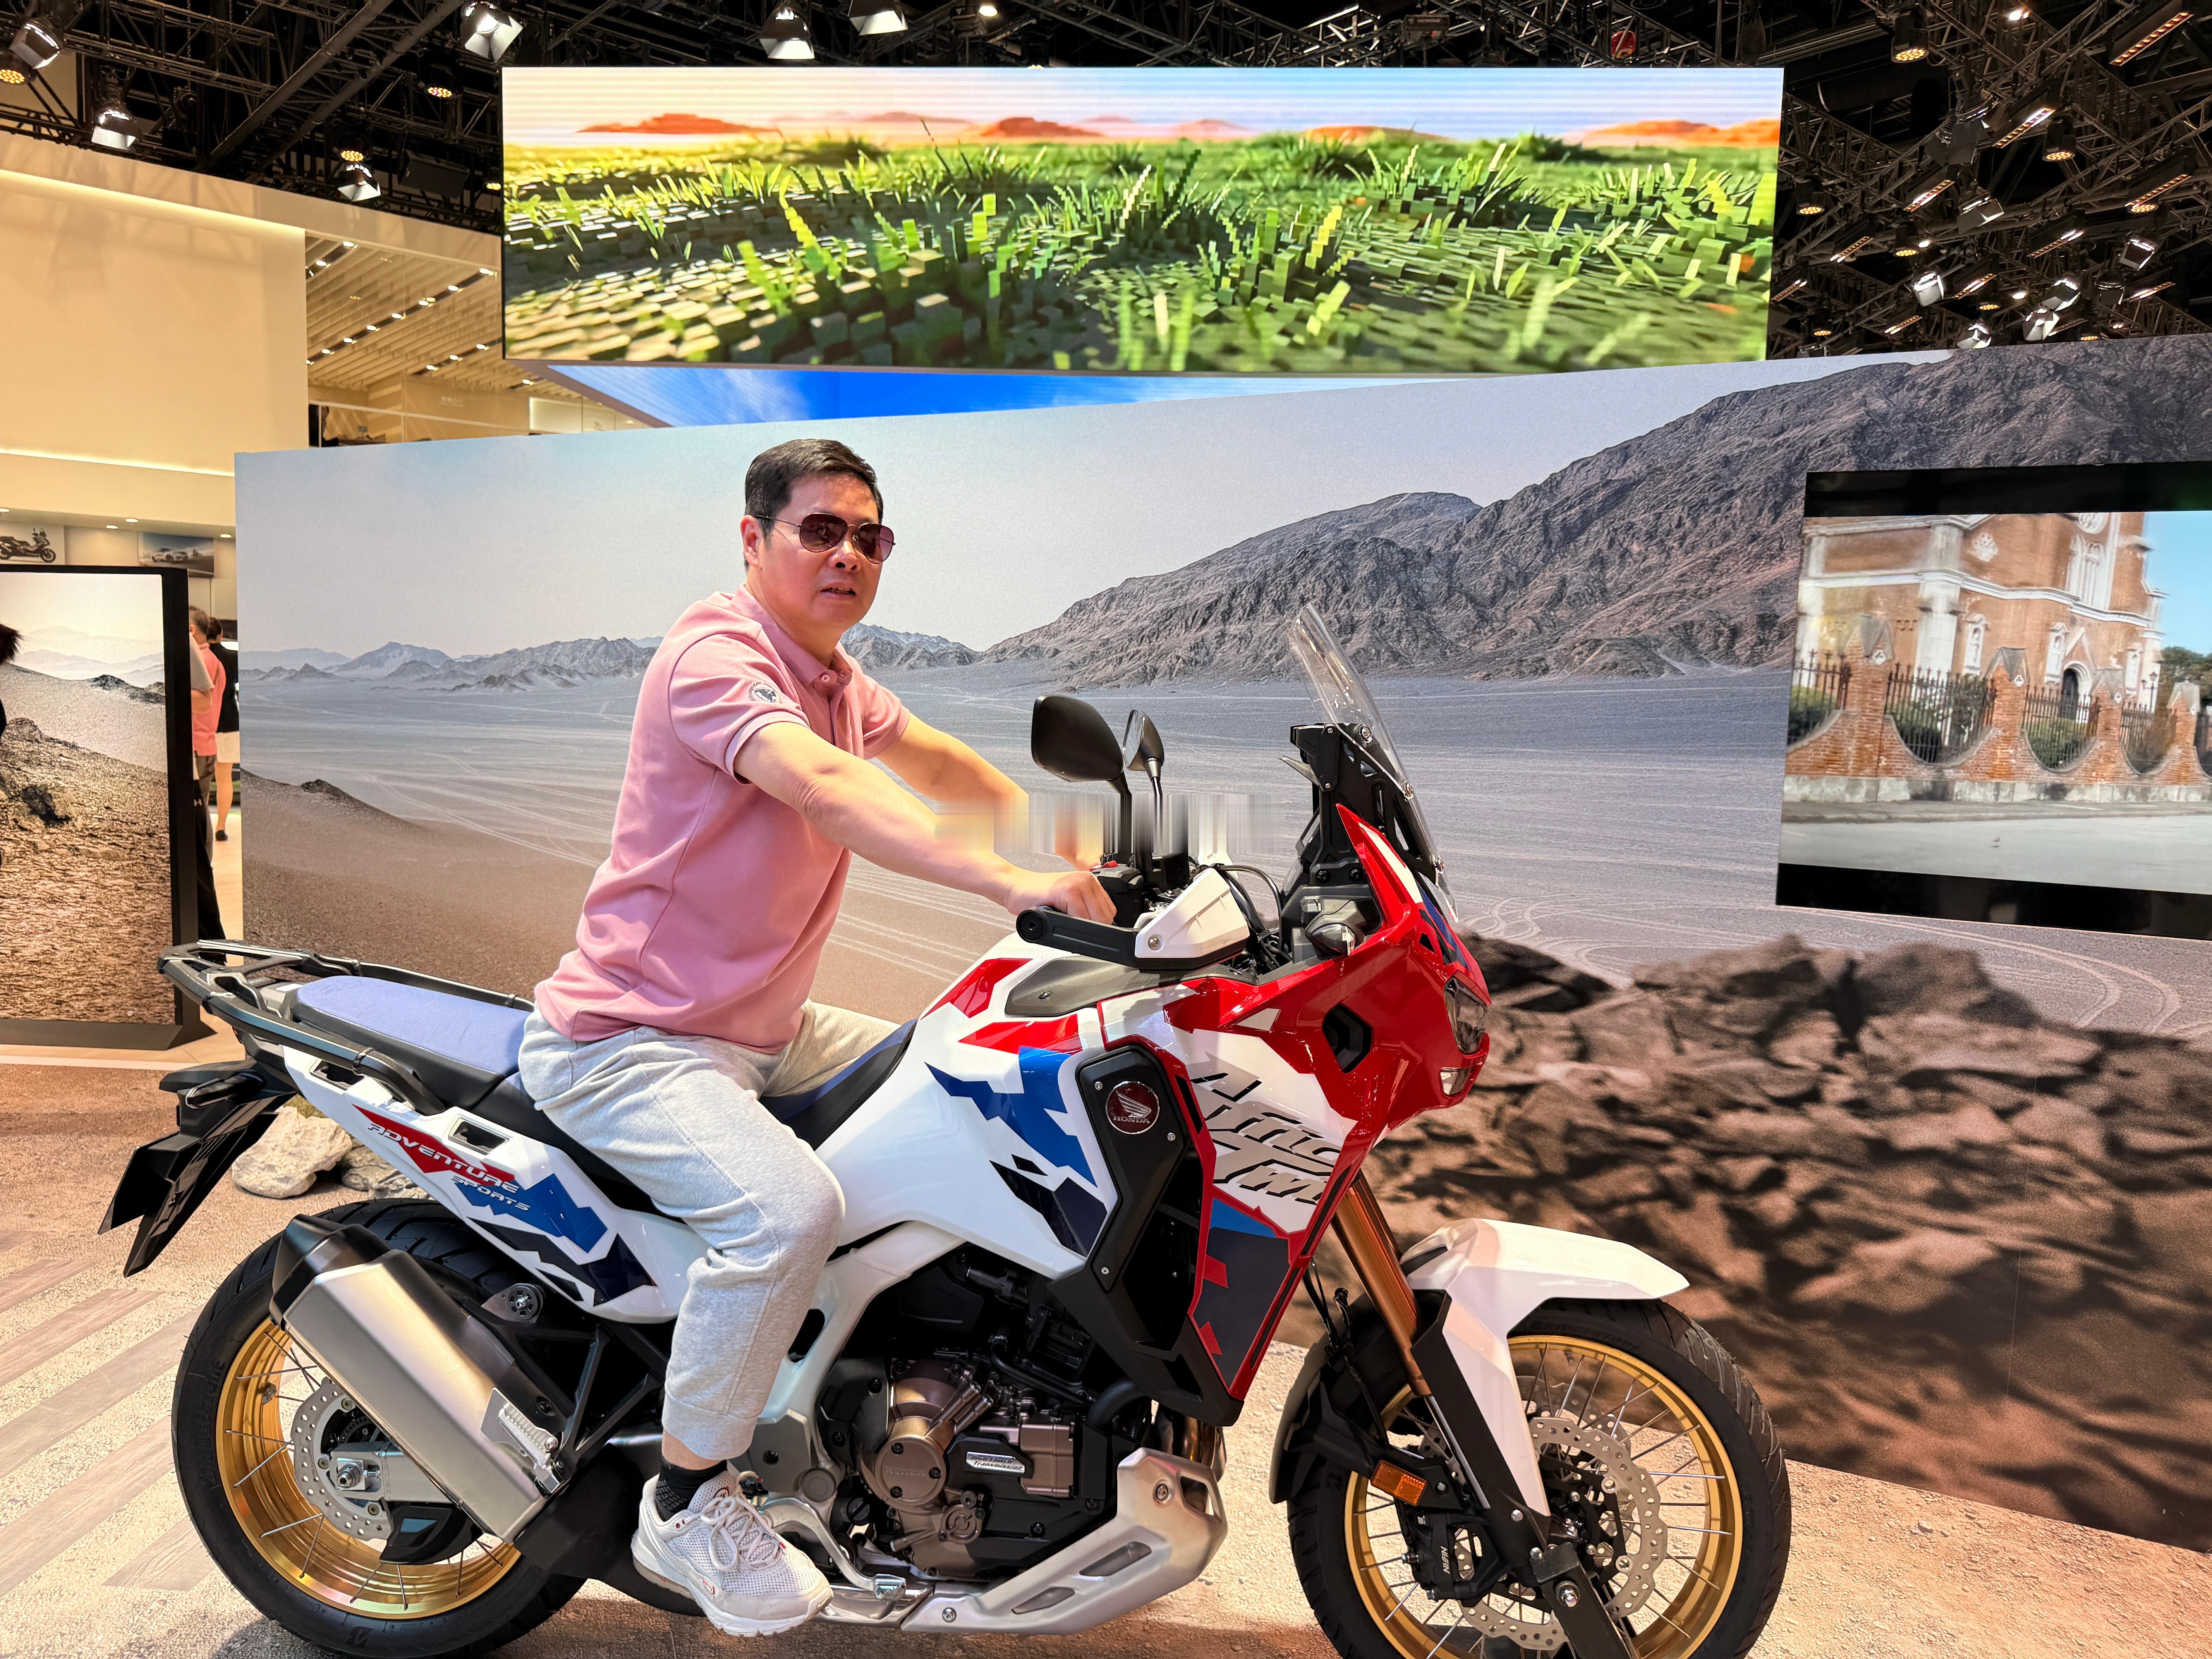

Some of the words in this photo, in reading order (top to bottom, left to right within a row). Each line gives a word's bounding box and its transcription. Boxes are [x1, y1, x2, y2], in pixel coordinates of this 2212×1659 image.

[1113, 1115, 1151, 1123] HONDA
[368, 1123, 520, 1194] ADVENTURE
[451, 1175, 531, 1211] SPORTS
[884, 1467, 927, 1476] HONDA
[973, 1461, 1024, 1470] Transmission
[1440, 1546, 1450, 1574] NISSIN
